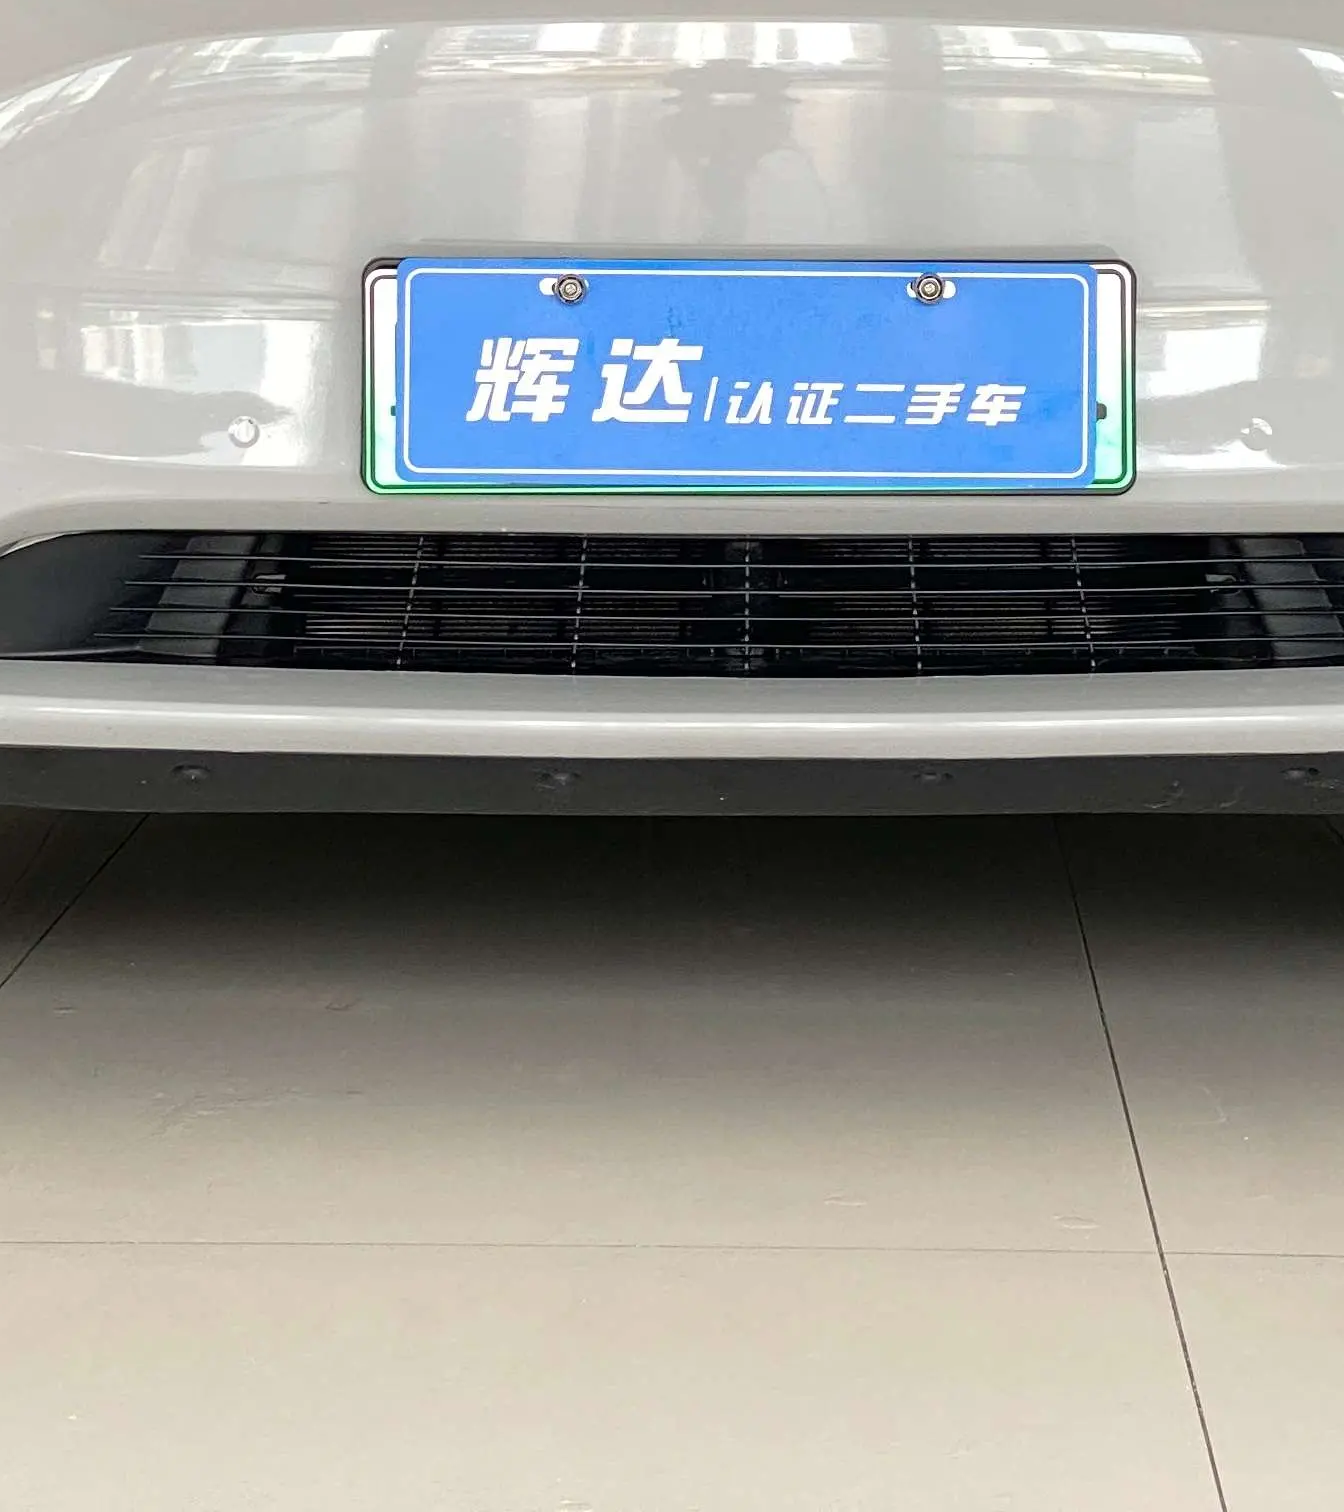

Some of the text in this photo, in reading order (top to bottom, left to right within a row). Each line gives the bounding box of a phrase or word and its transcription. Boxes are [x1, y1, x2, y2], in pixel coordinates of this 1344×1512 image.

[465, 336, 1027, 427] 辉达 认证二手车
